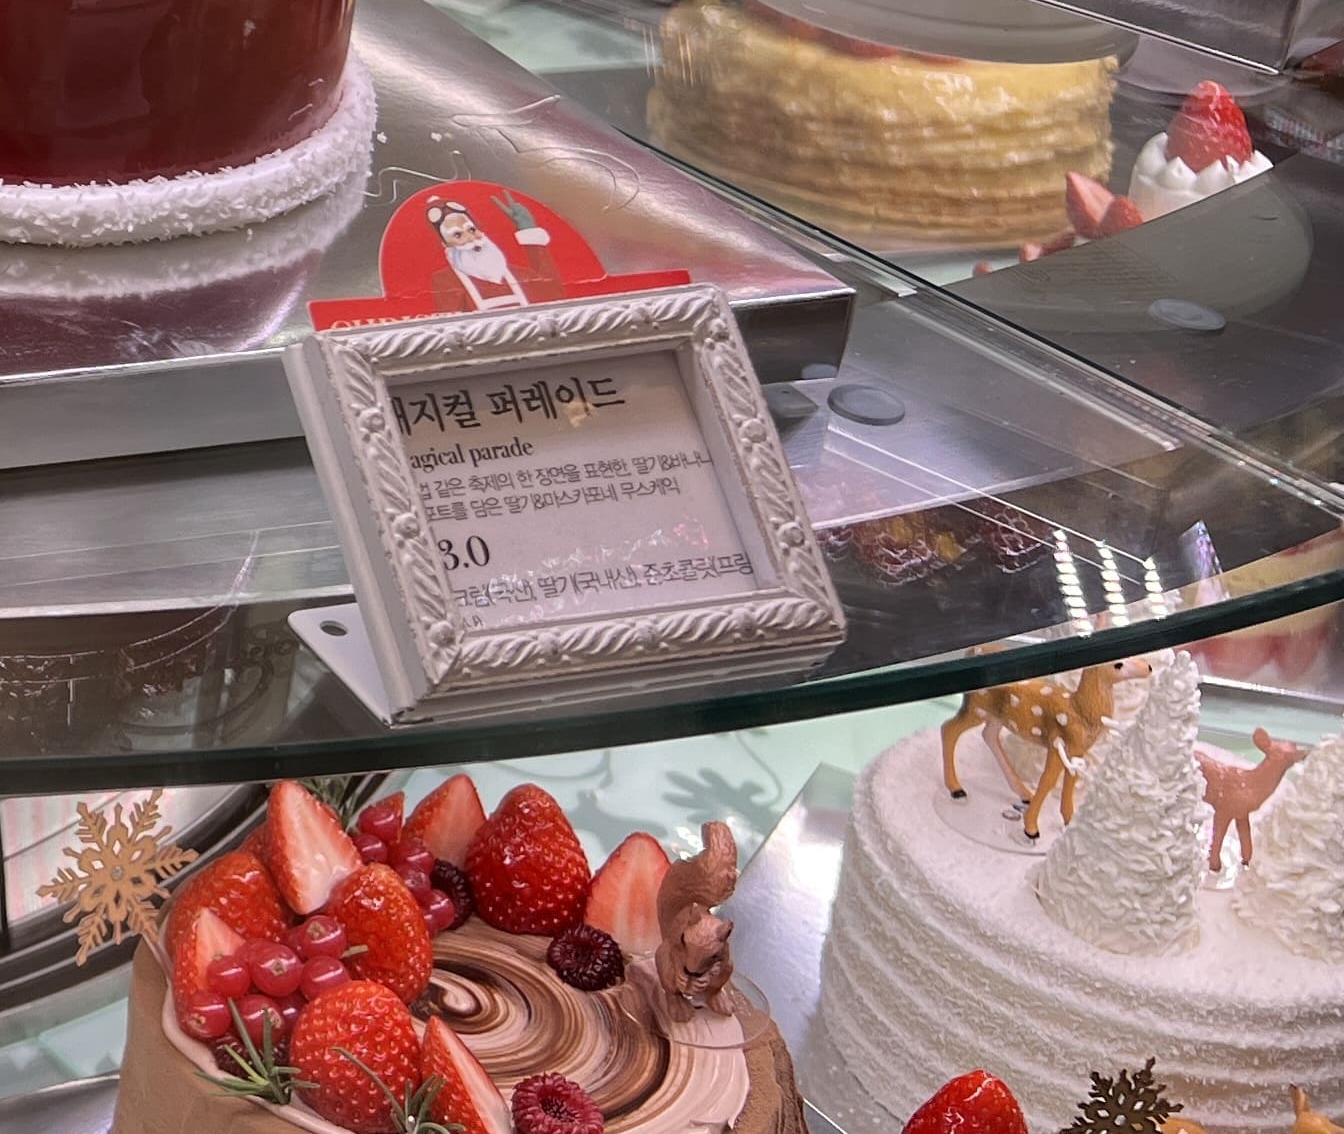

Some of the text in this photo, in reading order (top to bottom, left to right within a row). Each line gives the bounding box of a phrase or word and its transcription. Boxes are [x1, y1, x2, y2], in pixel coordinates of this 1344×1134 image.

[486, 377, 626, 424] 퍼레이드
[409, 436, 535, 474] agical parade
[433, 477, 466, 500] 같은
[468, 472, 515, 495] 축제의
[516, 470, 535, 490] 한
[469, 497, 503, 519] 담은
[620, 475, 682, 500] 무스케익
[437, 534, 491, 571] 3.0
